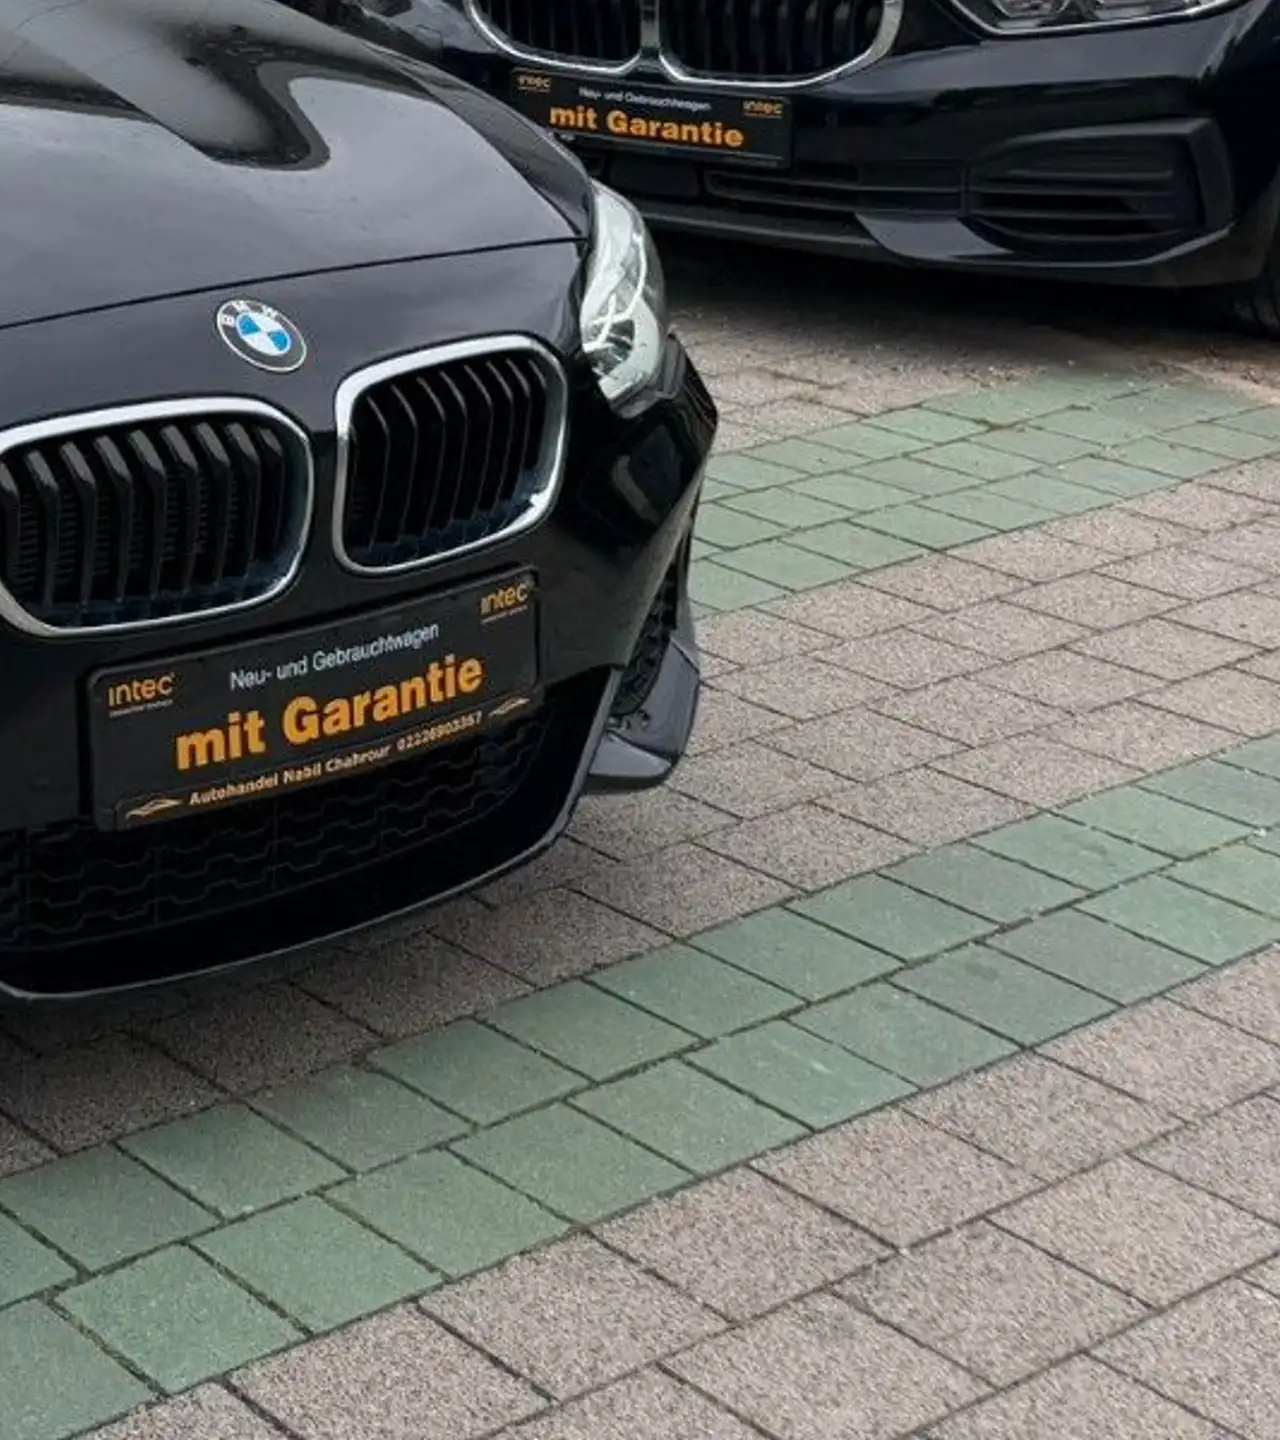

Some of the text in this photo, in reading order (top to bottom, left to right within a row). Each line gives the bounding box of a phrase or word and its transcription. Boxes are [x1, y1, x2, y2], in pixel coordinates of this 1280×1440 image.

[550, 104, 744, 148] mit Garantie
[230, 623, 440, 692] Neu- und Gebrauchtwagen
[108, 675, 174, 707] intec
[175, 654, 484, 771] mit Garantie
[189, 771, 279, 807] Autohandel
